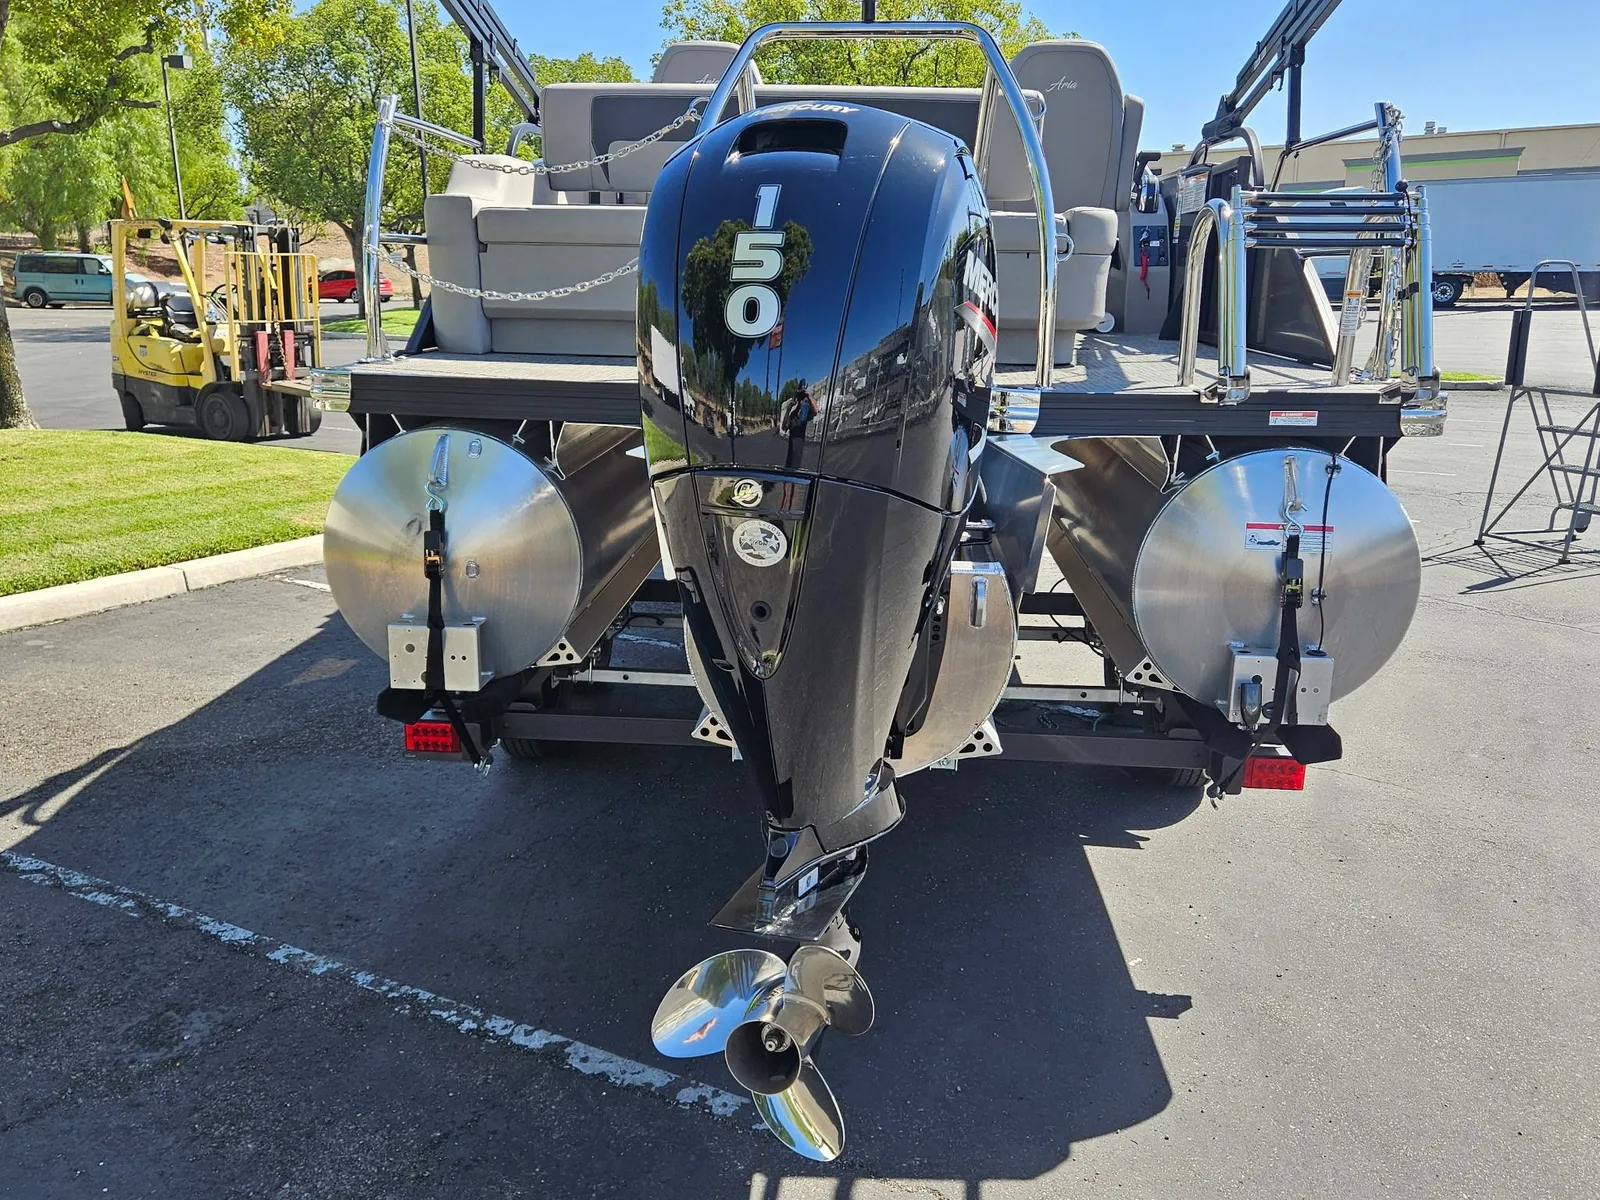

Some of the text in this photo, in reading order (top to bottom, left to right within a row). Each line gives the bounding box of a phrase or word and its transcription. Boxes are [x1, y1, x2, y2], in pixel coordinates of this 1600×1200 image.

[1046, 76, 1078, 92] Aria
[747, 103, 860, 118] MERCURY
[724, 184, 786, 338] 150
